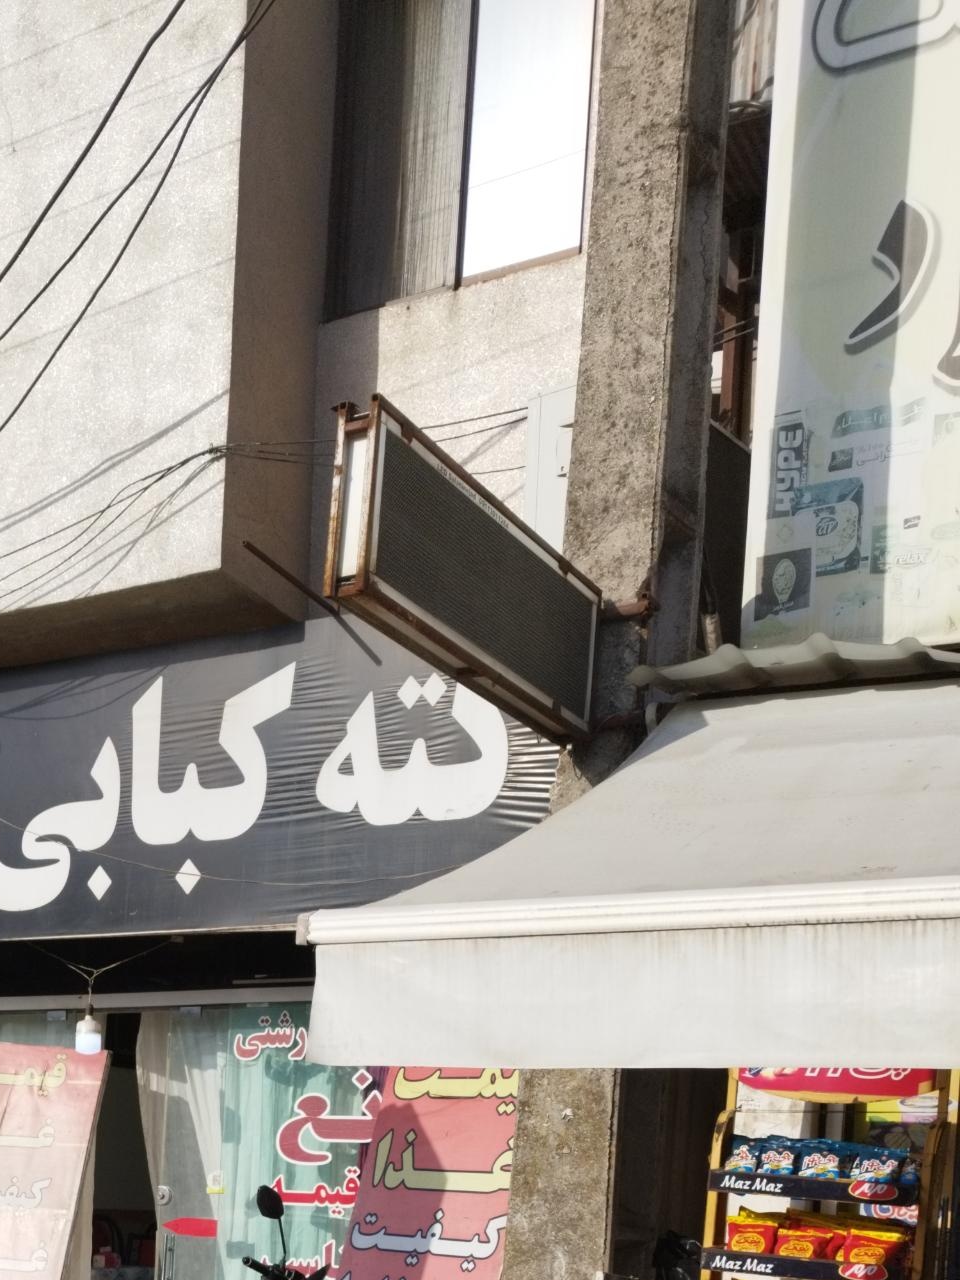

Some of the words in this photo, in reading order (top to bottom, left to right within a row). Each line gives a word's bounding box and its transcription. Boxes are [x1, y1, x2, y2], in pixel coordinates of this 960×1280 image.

[393, 1067, 519, 1116] یمت
[372, 1128, 514, 1194] غذا
[350, 1207, 507, 1272] کیفیت
